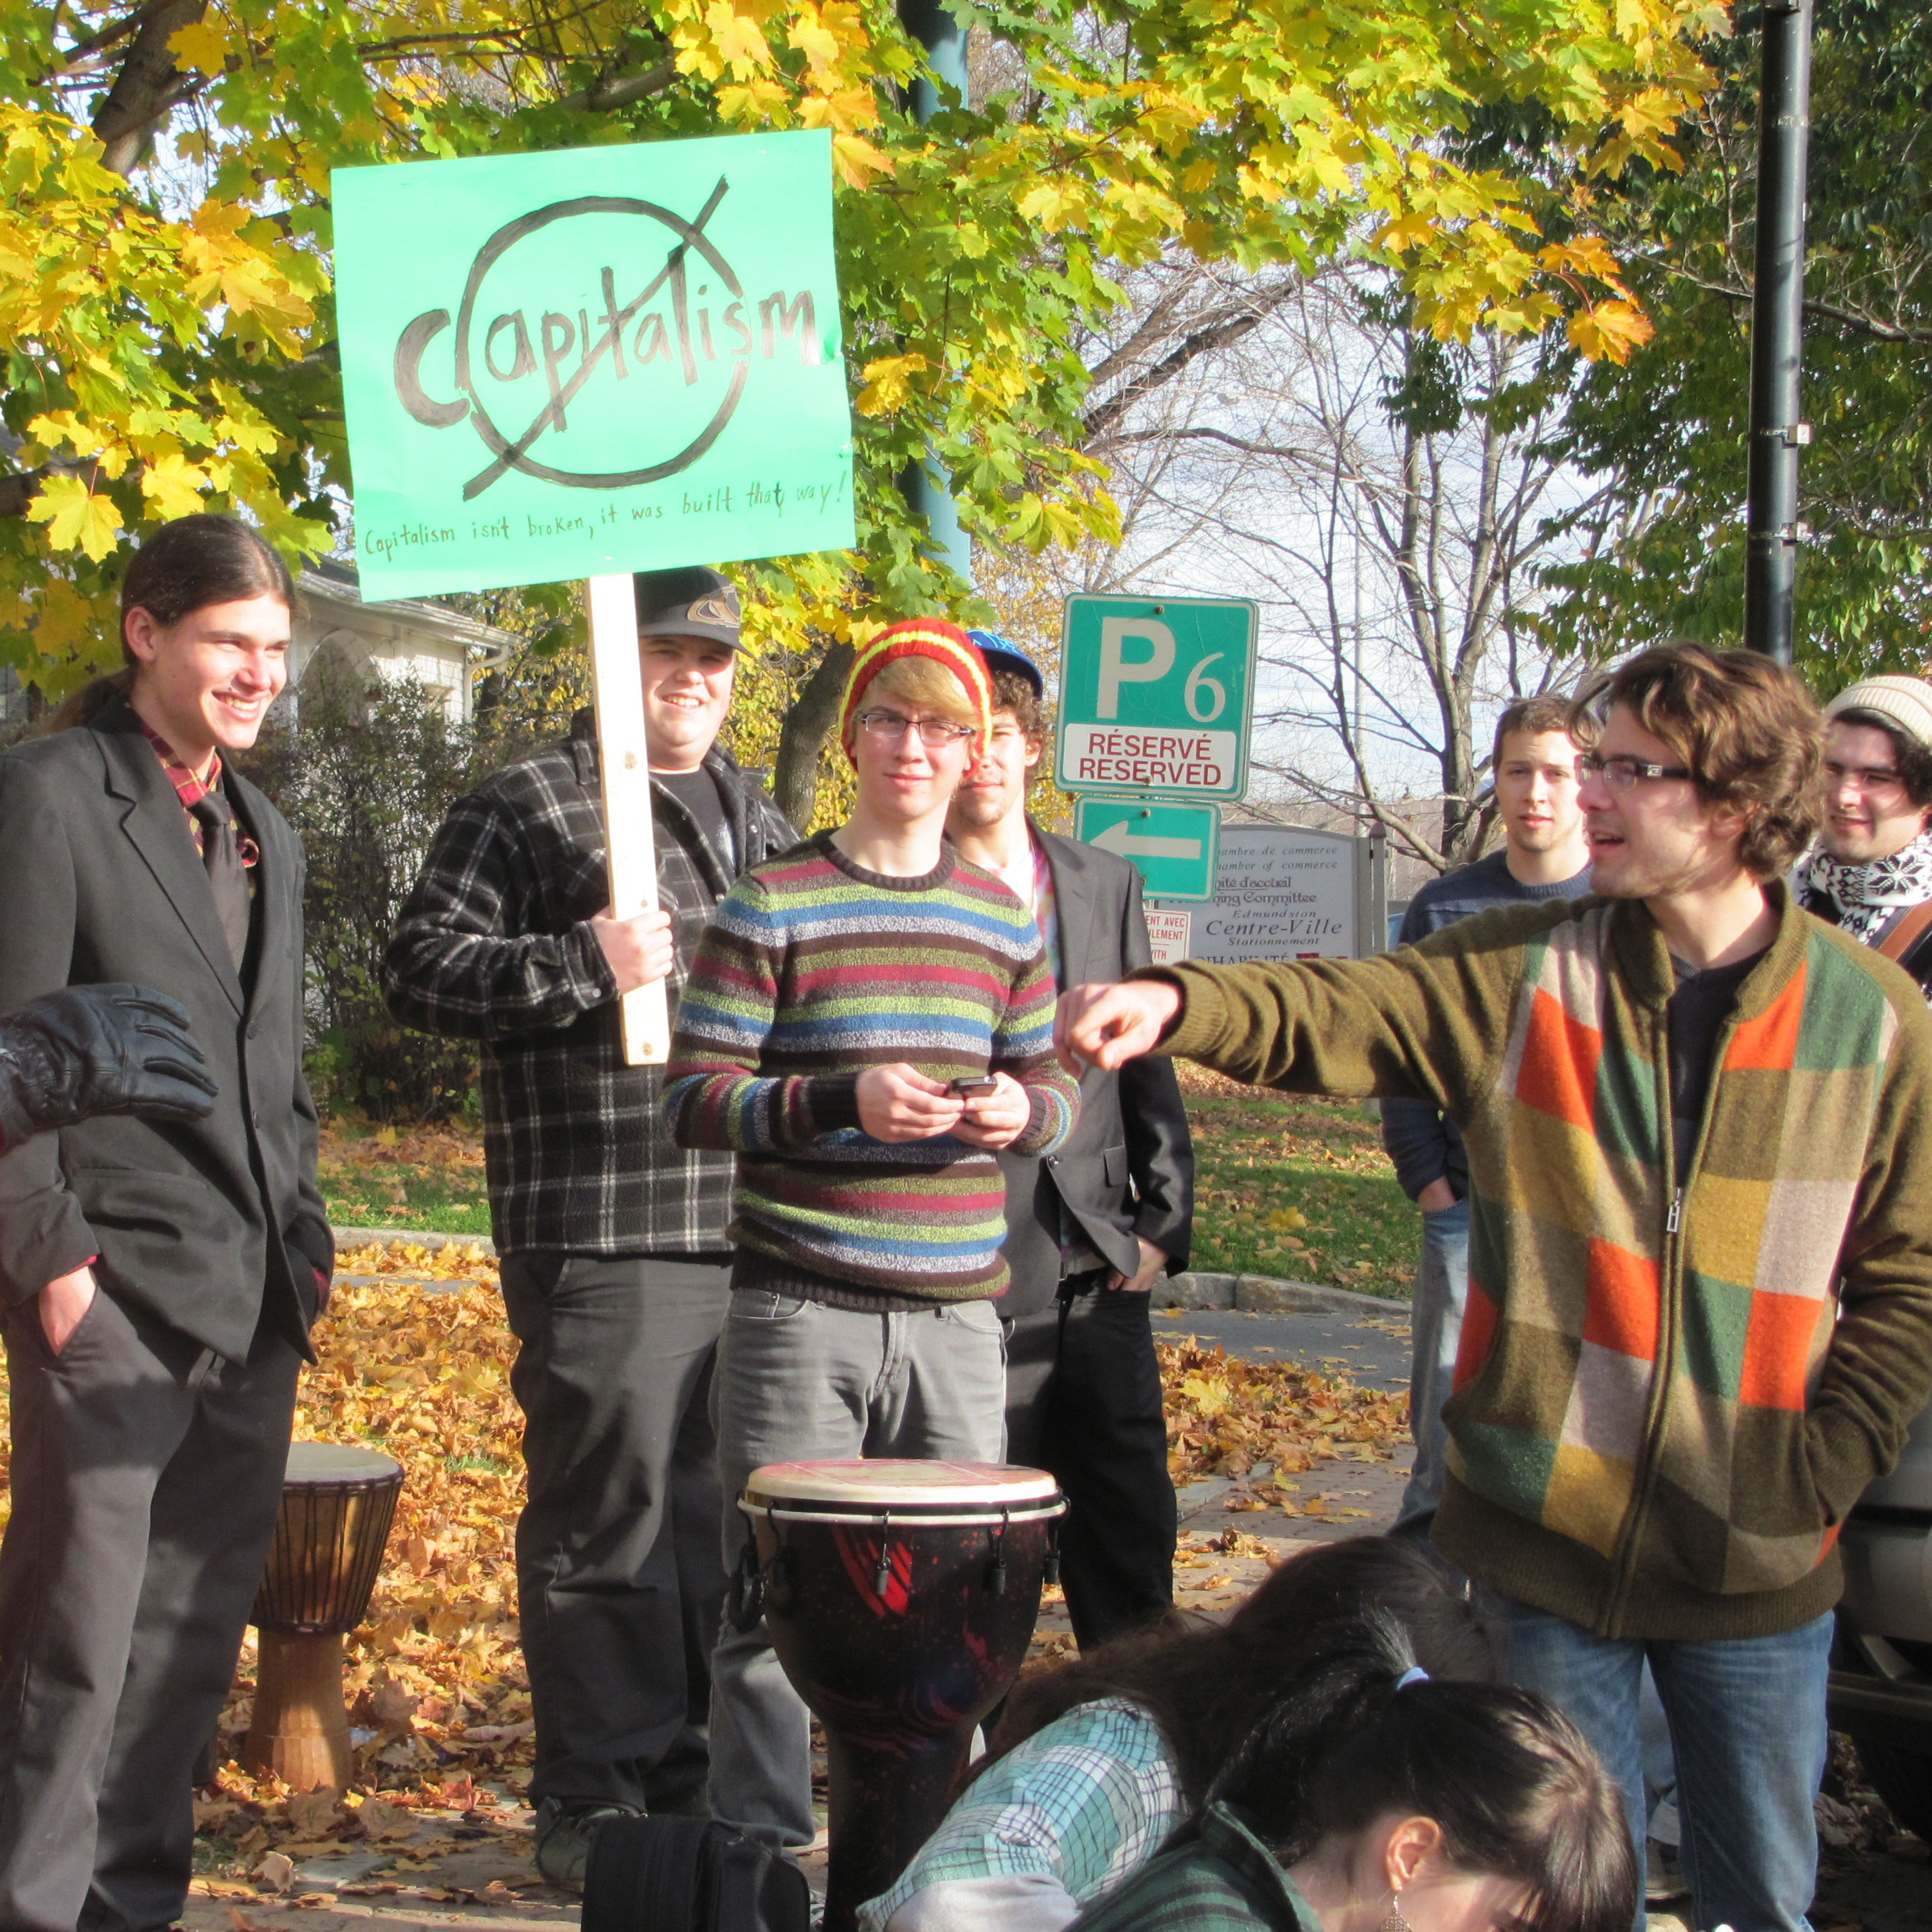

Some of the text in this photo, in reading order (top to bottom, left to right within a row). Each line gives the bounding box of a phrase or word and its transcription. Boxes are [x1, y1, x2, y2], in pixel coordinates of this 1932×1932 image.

[394, 248, 816, 432] Capitalism
[365, 523, 456, 562] Capitalism
[471, 516, 509, 539] isn't
[601, 503, 617, 524] it
[631, 505, 663, 521] was
[682, 486, 733, 514] built
[745, 481, 784, 511] that
[796, 471, 847, 515] way!
[1095, 616, 1226, 722] P 6
[1088, 729, 1212, 760] RÉSERVÉ
[1079, 758, 1221, 786] RESERVED
[1218, 846, 1338, 856] ambre de commerce
[1263, 860, 1274, 872] of
[1281, 861, 1338, 870] commerce
[1243, 891, 1317, 906] Committee
[1164, 917, 1184, 928] AVEC
[1206, 918, 1343, 936] Centre-Ville
[1227, 937, 1319, 946] Stationnement
